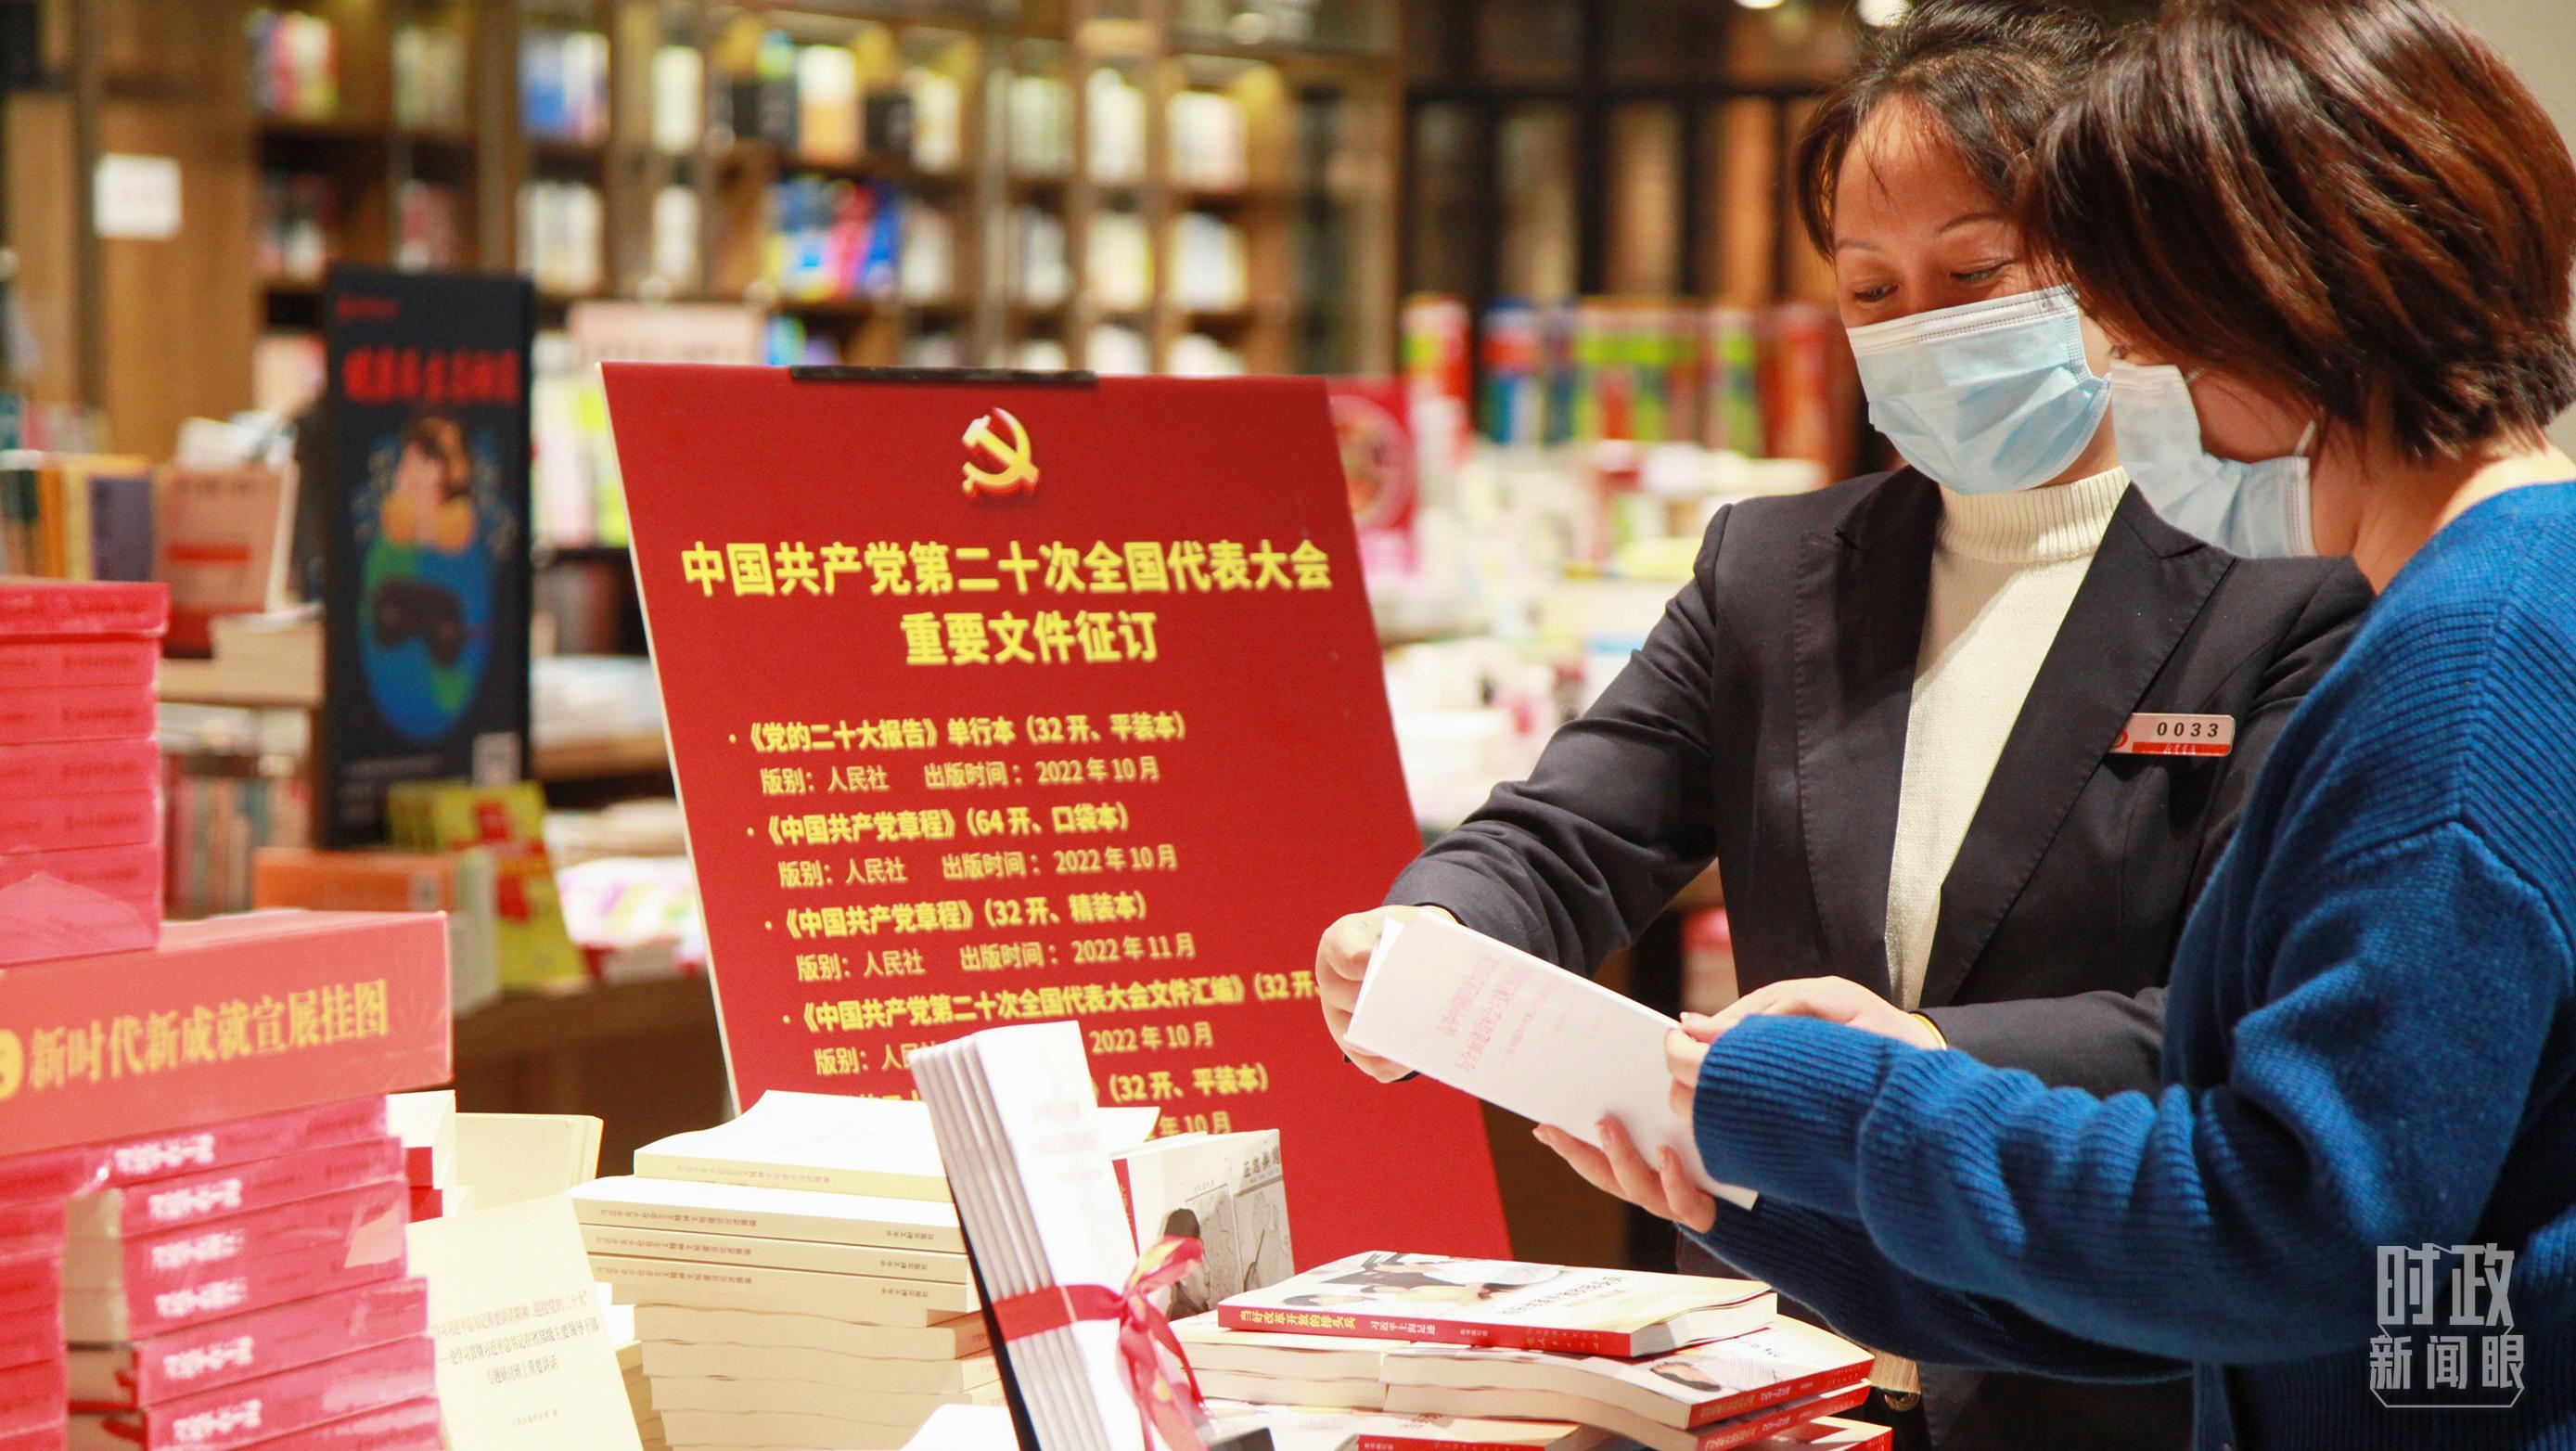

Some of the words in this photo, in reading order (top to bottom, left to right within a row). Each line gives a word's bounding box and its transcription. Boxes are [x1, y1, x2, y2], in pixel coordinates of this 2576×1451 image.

[682, 539, 1332, 597] 中国共产党第二十次全国代表大会
[900, 610, 1157, 665] 重要文件征订
[29, 978, 390, 1091] 新时代新成就宣展挂图
[1239, 1309, 1356, 1330] 当好改革开放的排头兵
